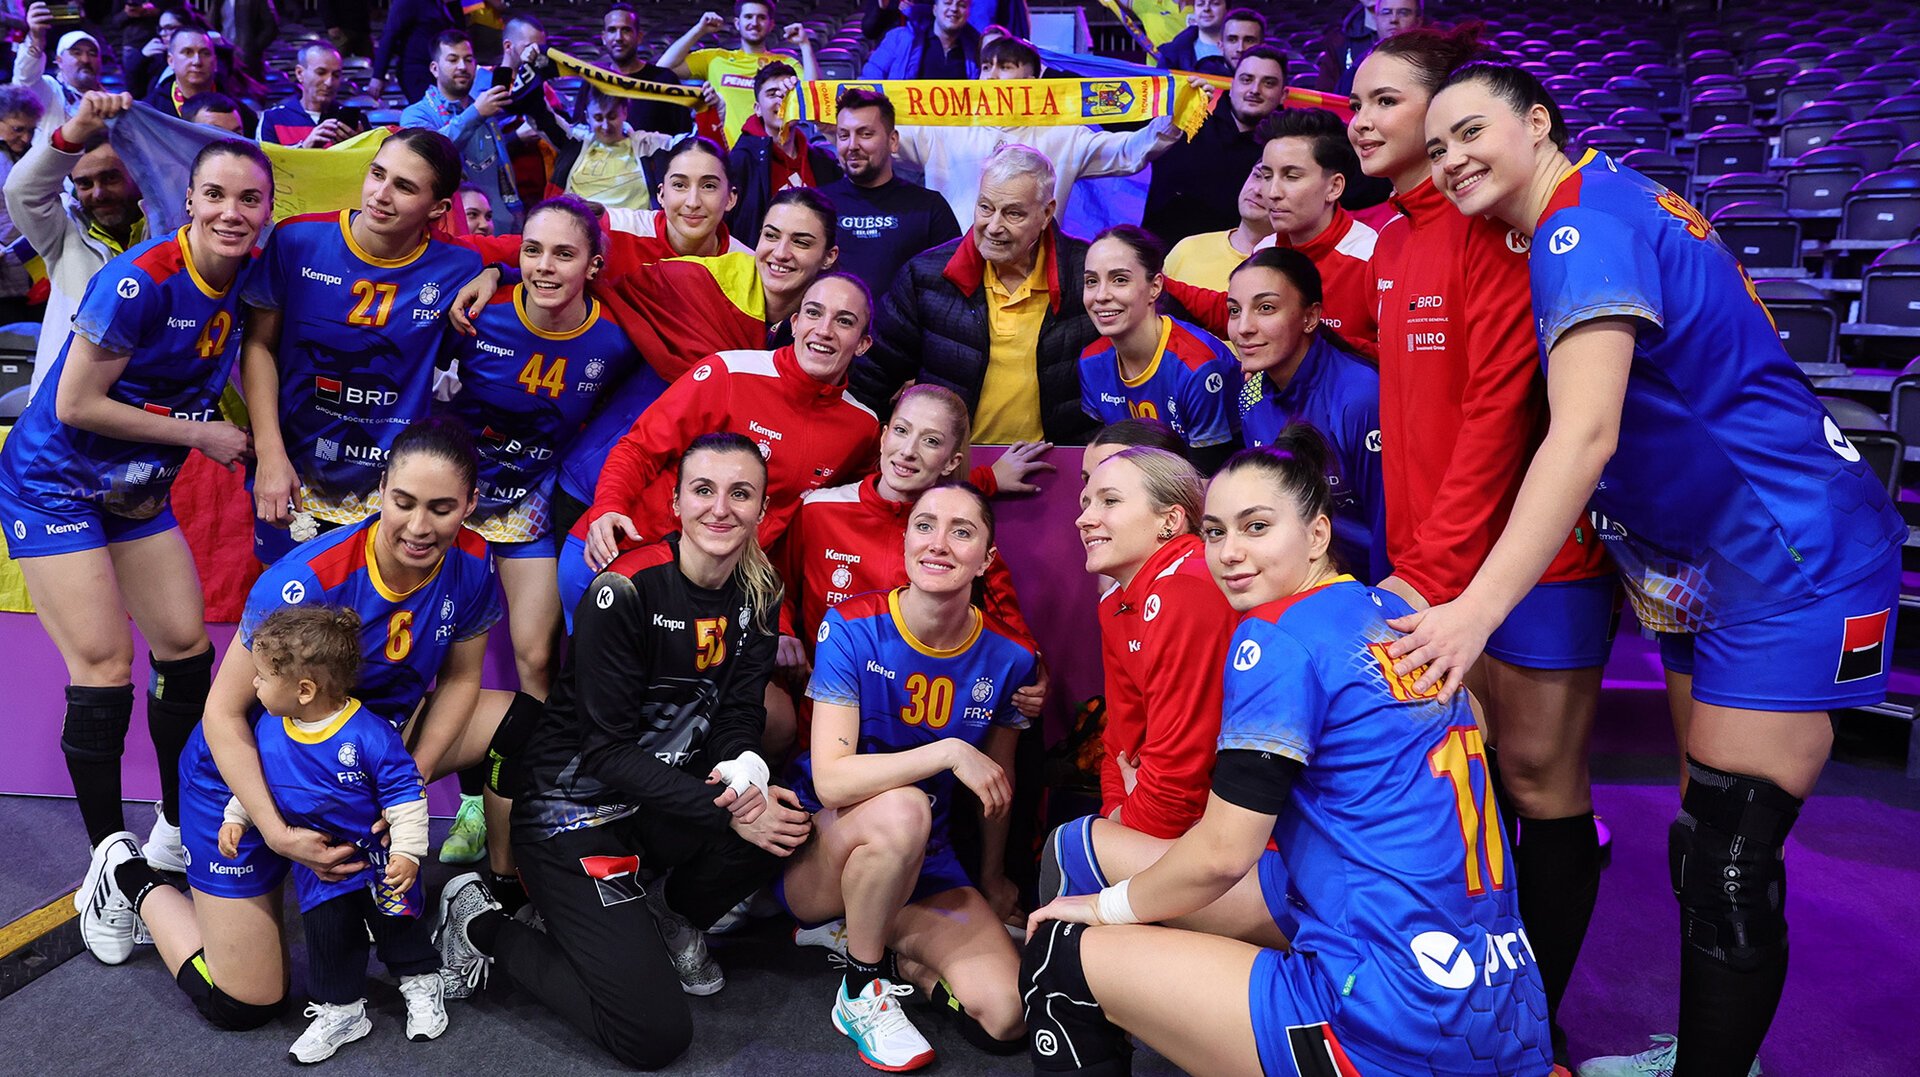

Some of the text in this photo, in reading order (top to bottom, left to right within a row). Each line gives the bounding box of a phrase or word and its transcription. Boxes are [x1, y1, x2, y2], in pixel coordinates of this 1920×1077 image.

[722, 76, 755, 88] PENN
[905, 86, 1060, 117] ROMANIA
[841, 216, 894, 229] GUESS
[301, 267, 342, 285] Kempa
[346, 278, 400, 329] 27
[1417, 296, 1443, 308] BRD
[195, 309, 233, 359] 42
[1415, 333, 1446, 345] NIRO
[476, 340, 515, 357] Kempa
[517, 352, 567, 398] 44
[346, 387, 399, 406] BRD
[749, 420, 783, 441] Kempa
[505, 439, 554, 461] BRD
[45, 520, 90, 535] Kempa
[825, 548, 861, 565] Kempa
[385, 609, 414, 662] 6
[902, 672, 956, 730] 30
[209, 861, 254, 878] Kempa
